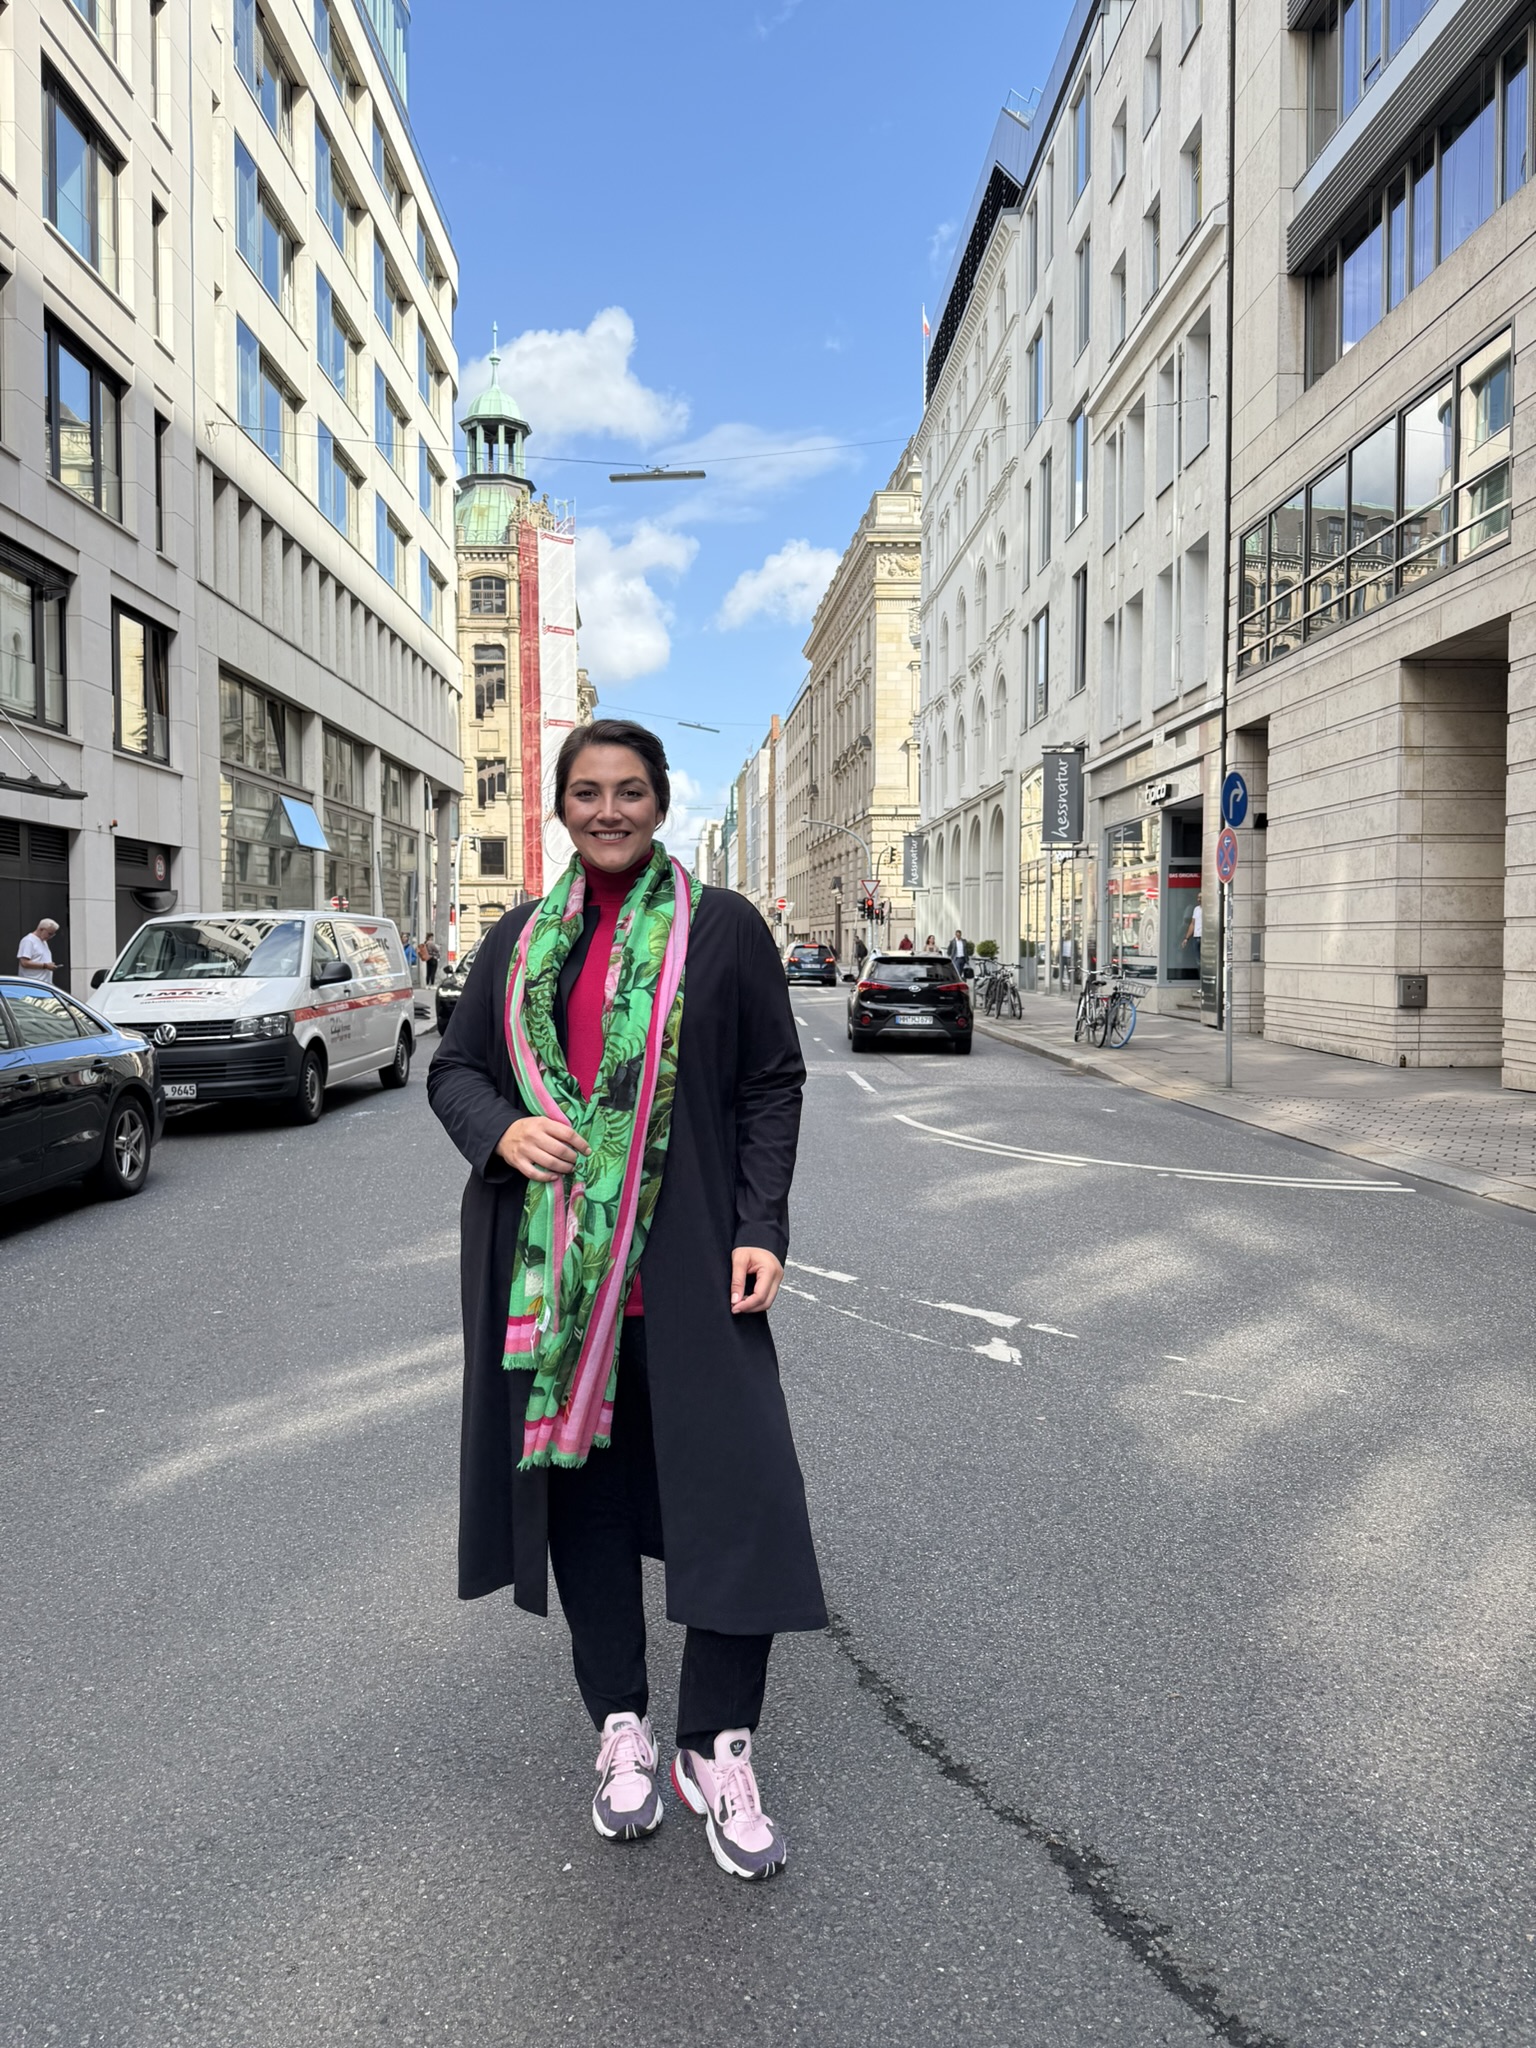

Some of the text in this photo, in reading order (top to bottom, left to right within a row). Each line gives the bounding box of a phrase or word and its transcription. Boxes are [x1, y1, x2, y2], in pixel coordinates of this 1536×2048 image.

[1051, 758, 1070, 838] hessnatur
[907, 839, 919, 885] hessnatur
[133, 990, 227, 999] ELMATIC
[171, 1086, 196, 1097] 9645
